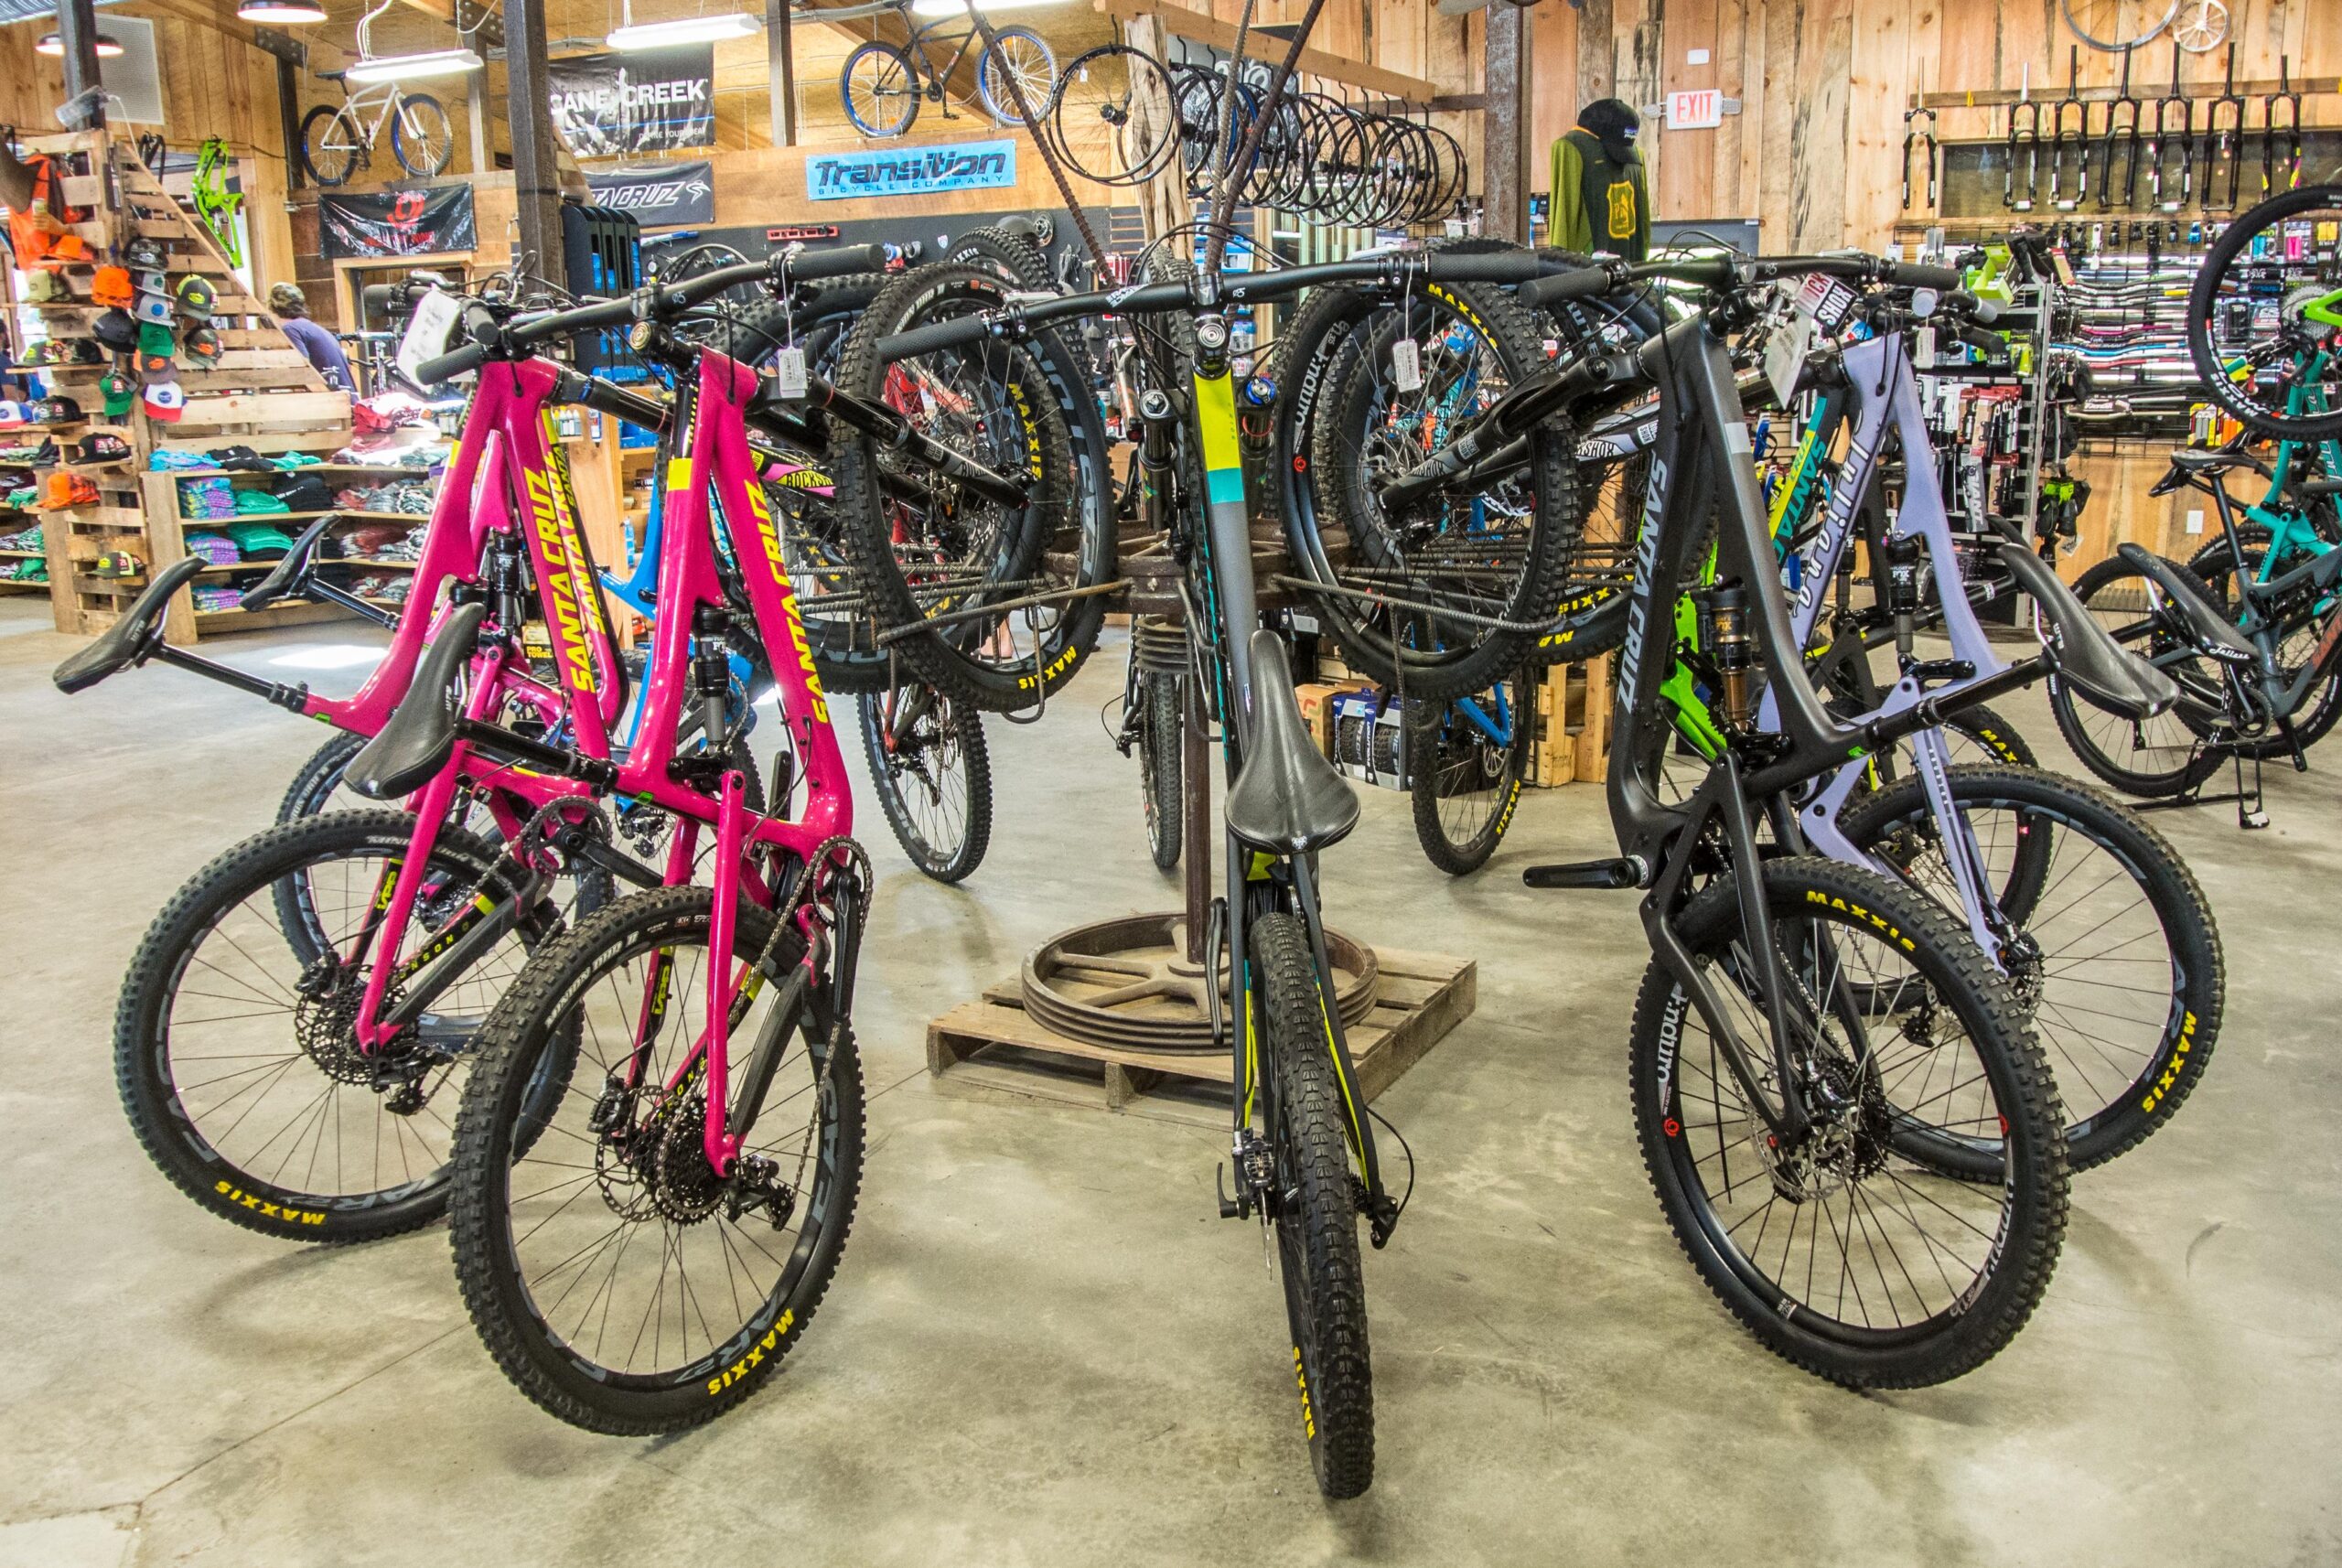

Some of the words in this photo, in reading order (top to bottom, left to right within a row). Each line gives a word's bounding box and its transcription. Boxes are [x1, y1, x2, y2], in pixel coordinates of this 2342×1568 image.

[551, 89, 610, 115] CANE
[620, 79, 707, 108] CREEK
[1676, 93, 1713, 124] EXIT
[815, 151, 1006, 186] Transition
[818, 184, 895, 195] BICYCLE
[912, 175, 1003, 189] COMPANY
[1428, 282, 1498, 349] MAXXIS
[1817, 286, 1852, 326] SHOX
[1007, 382, 1042, 479] MAXXIS
[2210, 372, 2259, 418] MAXXIS
[1633, 450, 1669, 597] SANTA
[1778, 435, 1826, 538] SANTA
[1792, 409, 1870, 618] Juliana
[523, 467, 567, 567] CRUZ
[548, 570, 596, 693] SANTA
[562, 533, 606, 635] SANTA
[744, 478, 792, 586] CRUZ
[780, 595, 831, 724] SANTA
[1617, 598, 1646, 714] CRUZ
[1979, 729, 2018, 763] MAX
[1496, 779, 1521, 835] MAXXIS
[1806, 889, 1917, 952] MAXXIS
[2141, 1010, 2197, 1114] MAXXIS
[213, 1180, 326, 1225] MAXXIS
[707, 1307, 794, 1395] MAXXIS
[1292, 1345, 1316, 1441] MAXXIS
